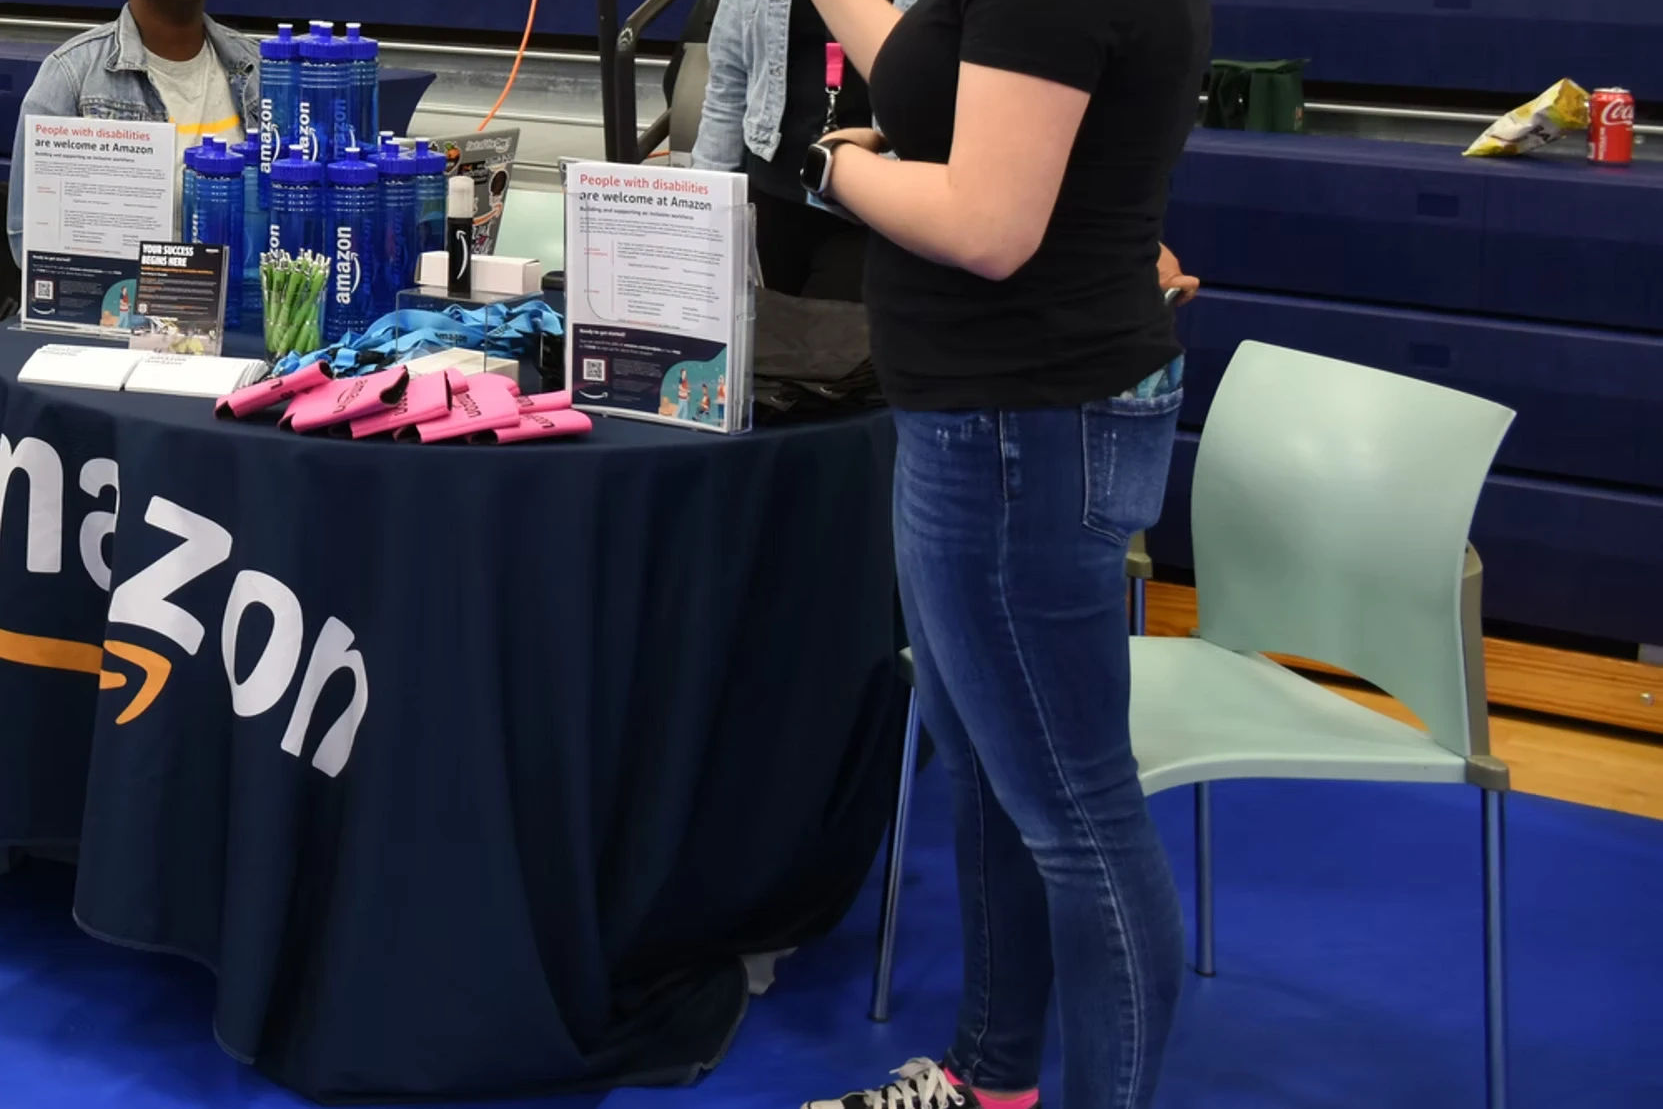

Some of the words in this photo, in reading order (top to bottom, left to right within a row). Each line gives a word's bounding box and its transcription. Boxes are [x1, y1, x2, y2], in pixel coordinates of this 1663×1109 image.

[35, 124, 69, 136] People
[72, 127, 94, 137] with
[96, 129, 150, 141] disabilities
[260, 98, 272, 173] amazon
[35, 139, 51, 147] are
[54, 139, 97, 151] welcome
[99, 143, 110, 151] at
[112, 144, 153, 154] Amazon
[580, 174, 621, 188] People
[624, 177, 649, 189] with
[652, 180, 709, 195] disabilities
[579, 192, 599, 201] are
[602, 192, 653, 205] welcome
[656, 195, 668, 206] at
[671, 197, 712, 211] Amazon
[163, 245, 194, 256] SUCCESS
[337, 227, 351, 304] amazon
